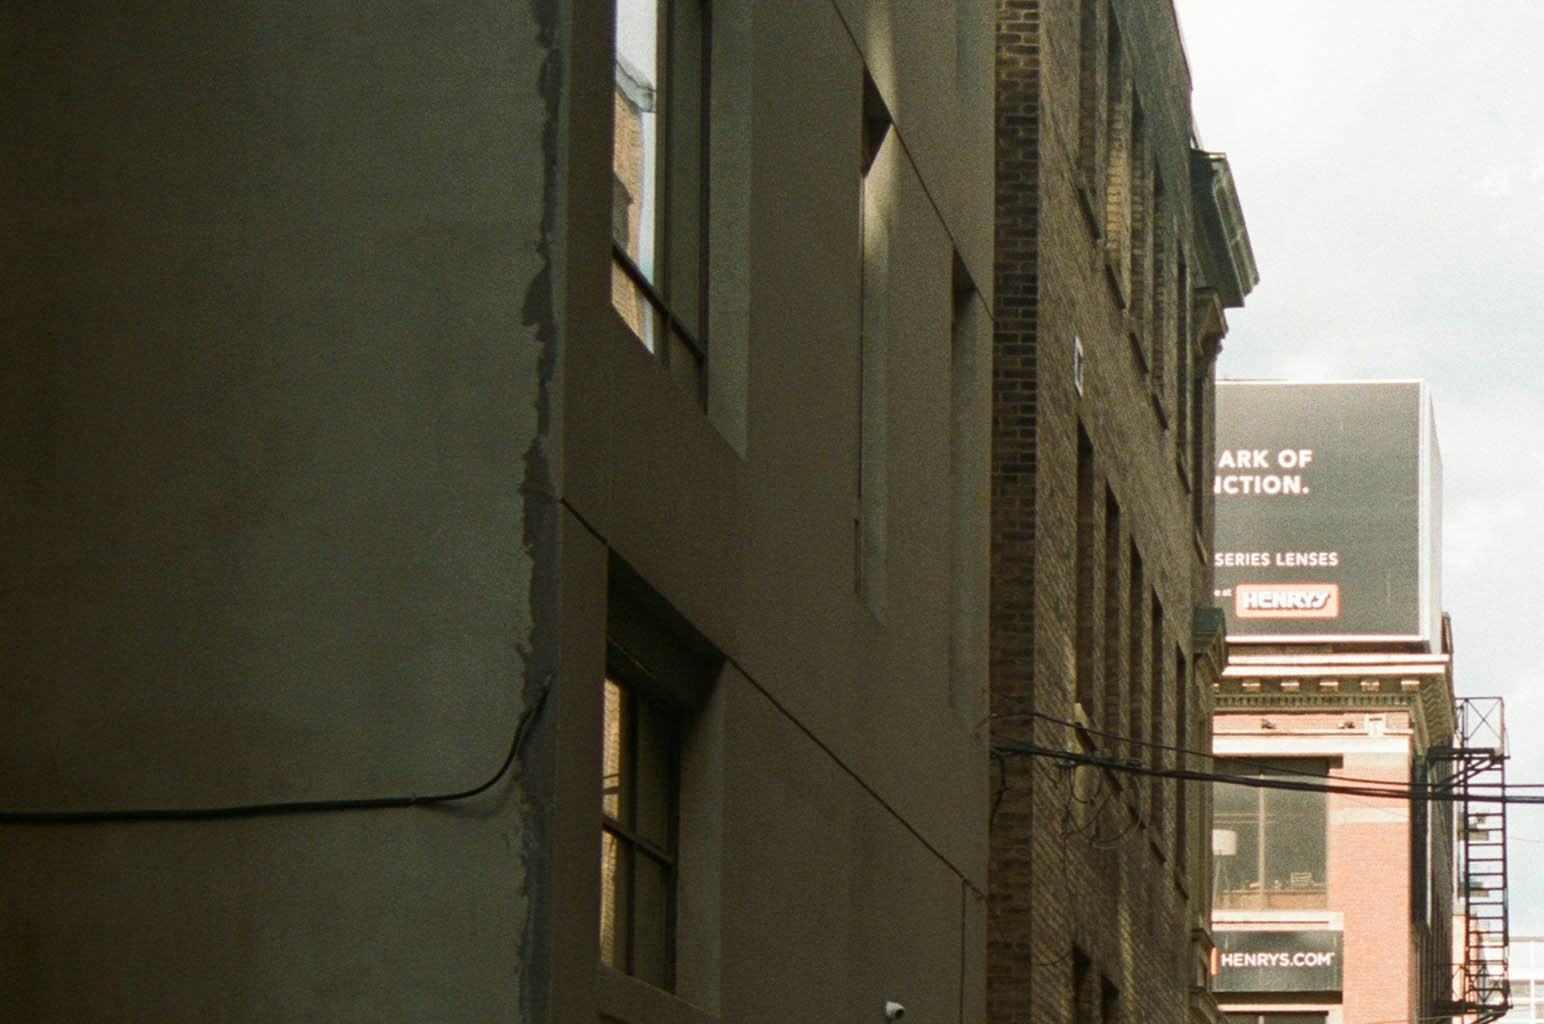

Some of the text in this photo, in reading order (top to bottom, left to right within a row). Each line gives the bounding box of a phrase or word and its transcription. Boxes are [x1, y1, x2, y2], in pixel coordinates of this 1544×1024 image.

[1278, 448, 1313, 469] OF
[1214, 552, 1339, 567] SERIES LENSES
[1221, 952, 1331, 967] HENRYS.COM
